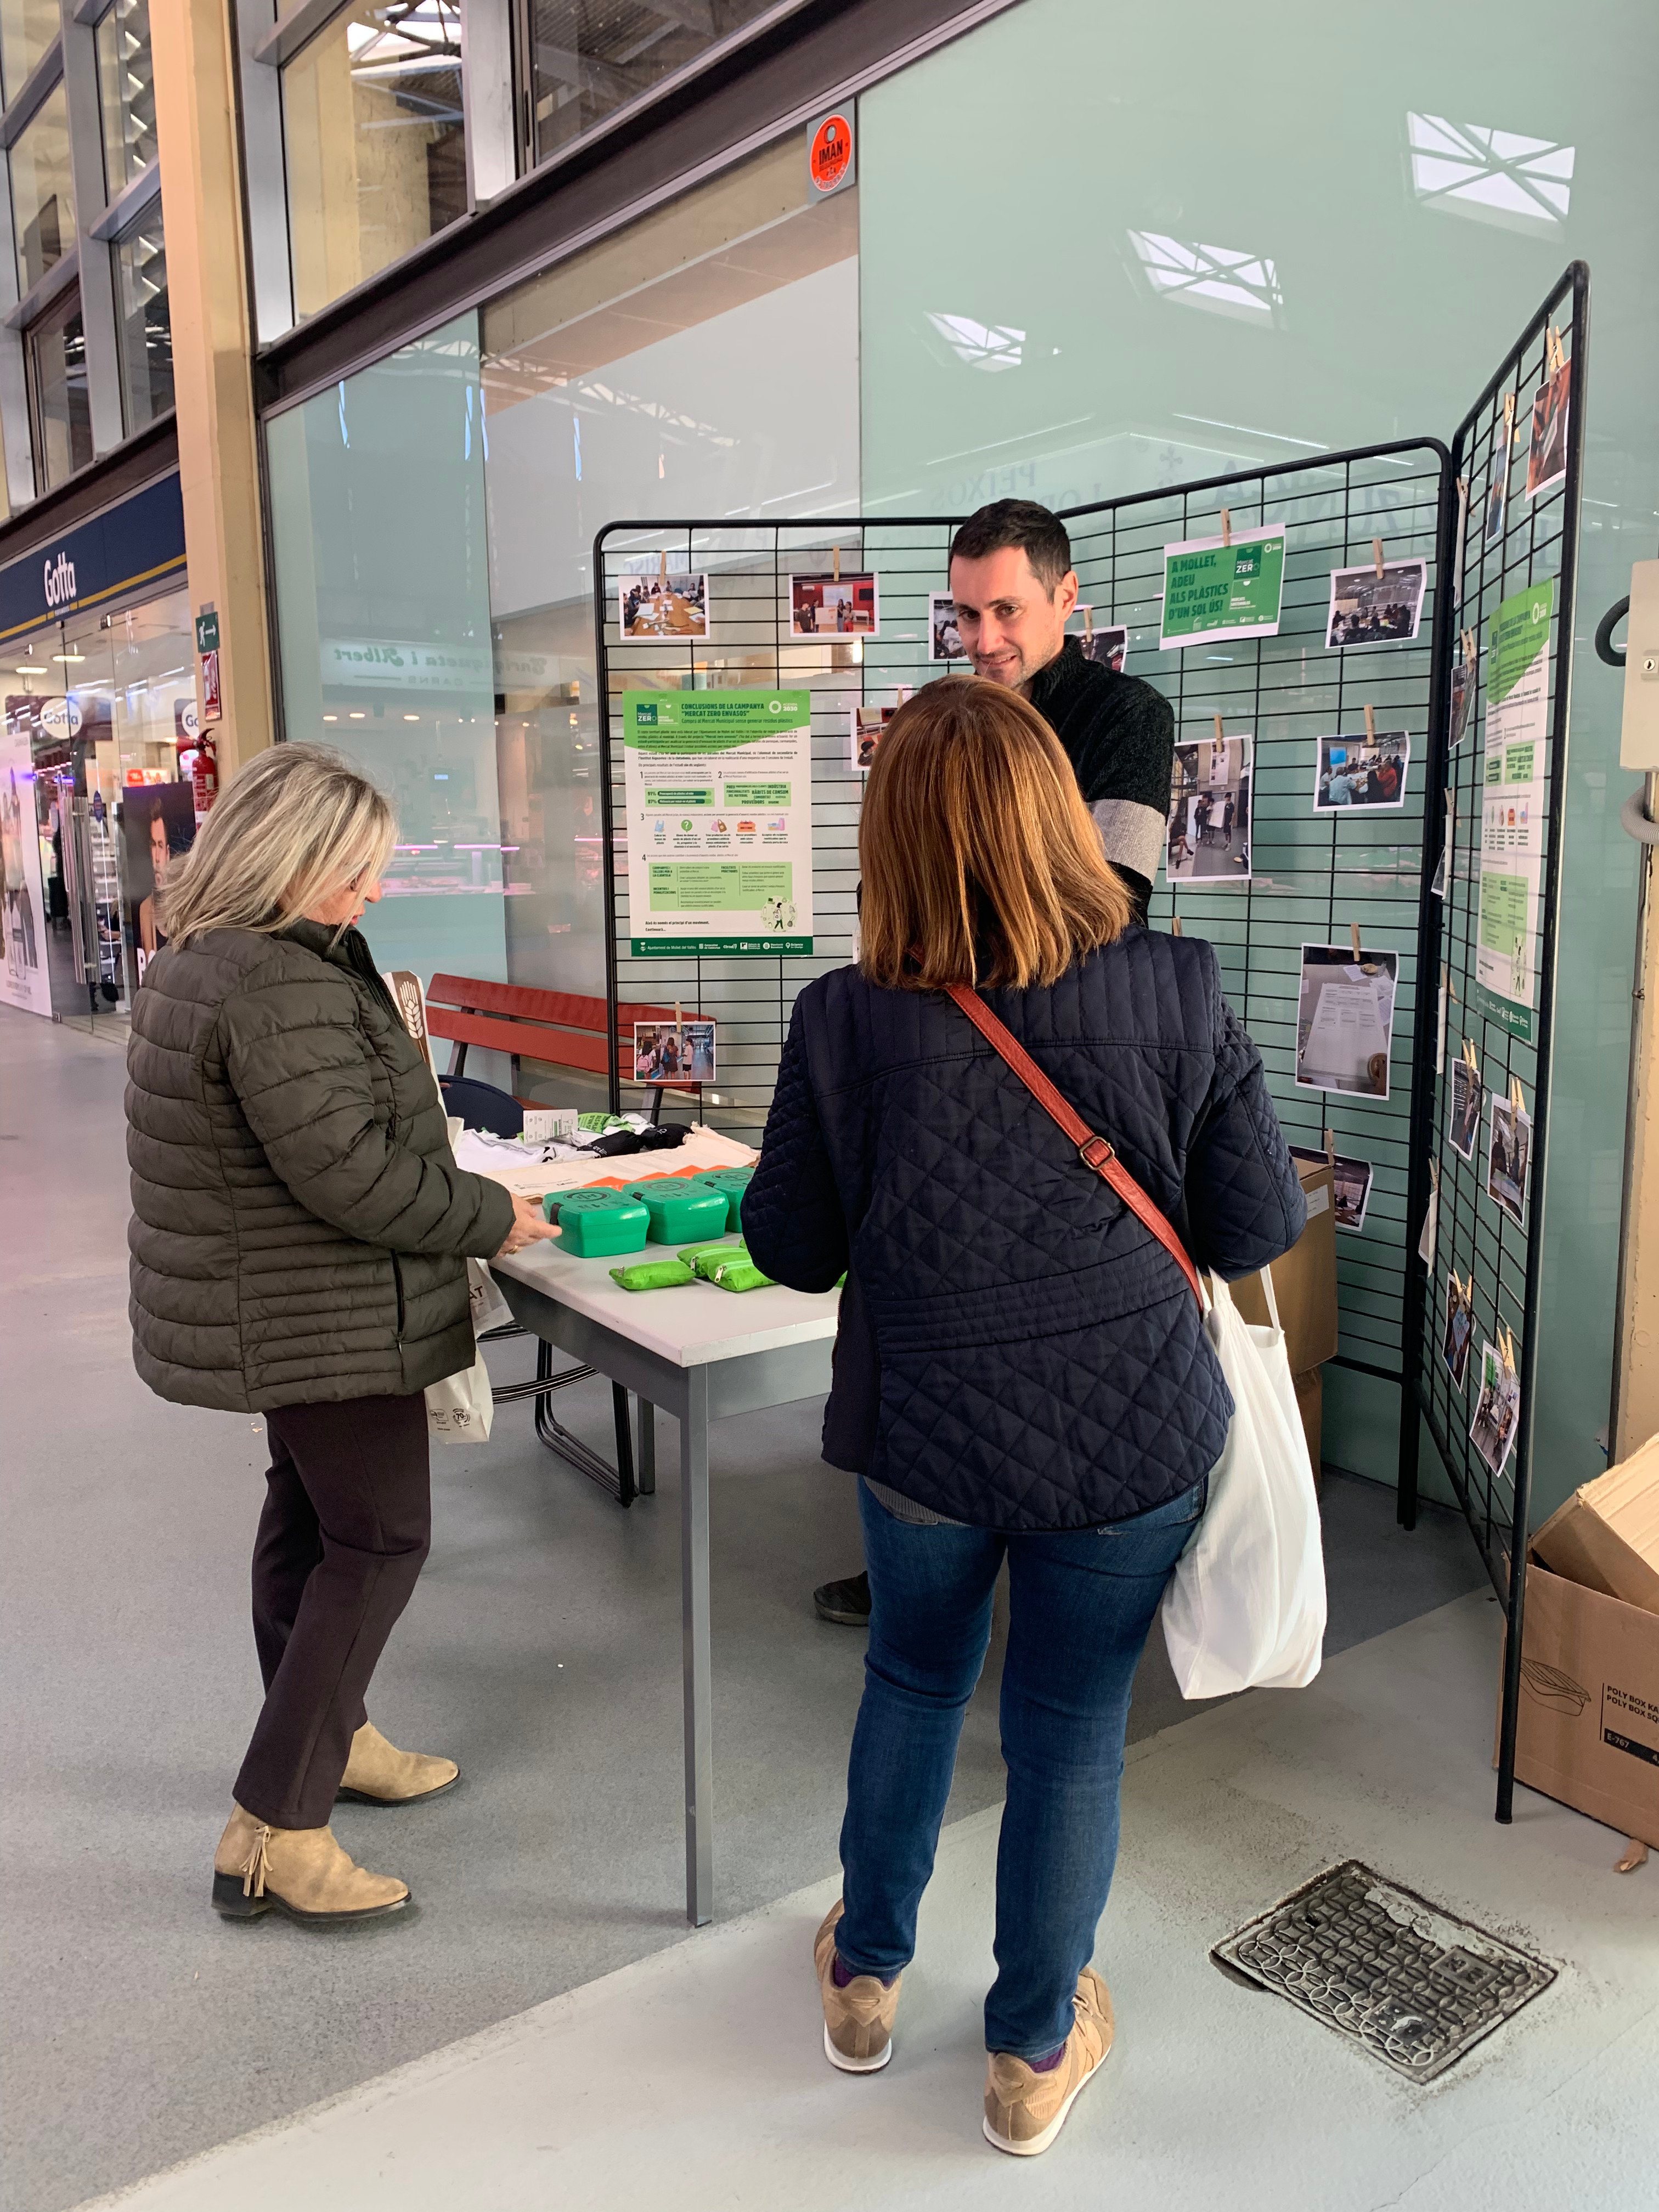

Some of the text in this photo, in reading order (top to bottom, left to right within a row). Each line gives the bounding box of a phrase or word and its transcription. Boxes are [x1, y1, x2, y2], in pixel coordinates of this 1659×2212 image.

[819, 139, 843, 165] IMAN
[1172, 554, 1216, 574] A MOLLET,
[1236, 563, 1260, 574] ZERO
[44, 551, 76, 607] Gotta
[1171, 574, 1195, 589] ADEU
[1170, 583, 1229, 605] ALS PLÀSTICS
[1168, 608, 1189, 620] D'UN
[1191, 604, 1206, 617] SOL
[1209, 599, 1223, 613] ÚS!
[1607, 1685, 1627, 1699] POLY
[1629, 1695, 1646, 1708] BOX
[1607, 1695, 1659, 1724] POLY BOX SQ
[1607, 1733, 1629, 1748] E-767
